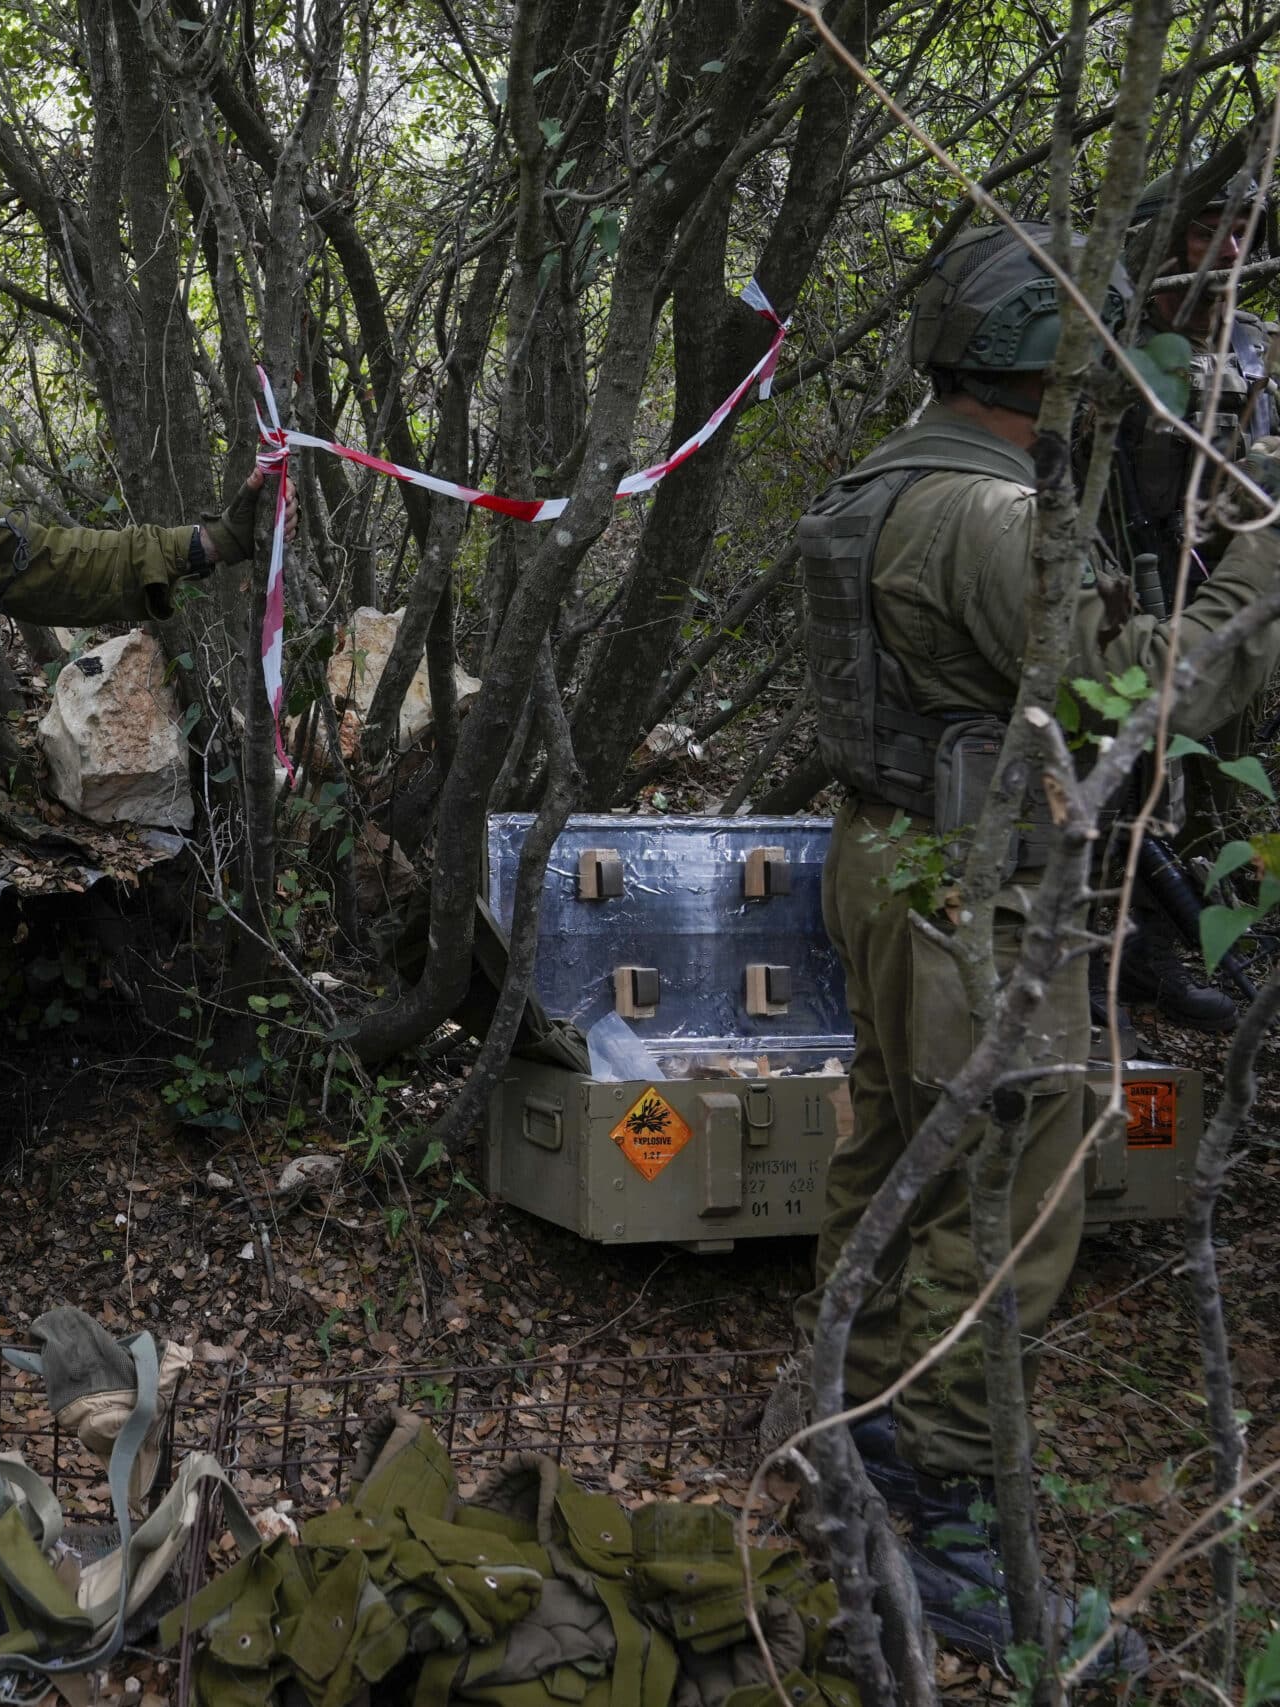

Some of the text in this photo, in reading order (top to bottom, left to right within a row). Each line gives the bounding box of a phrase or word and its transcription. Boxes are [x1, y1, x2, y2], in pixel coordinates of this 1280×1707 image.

[1130, 1087, 1158, 1096] DANGER
[634, 1136, 672, 1145] EXPLOSIVE
[790, 1177, 815, 1193] 628
[752, 1200, 801, 1216] 01 11
